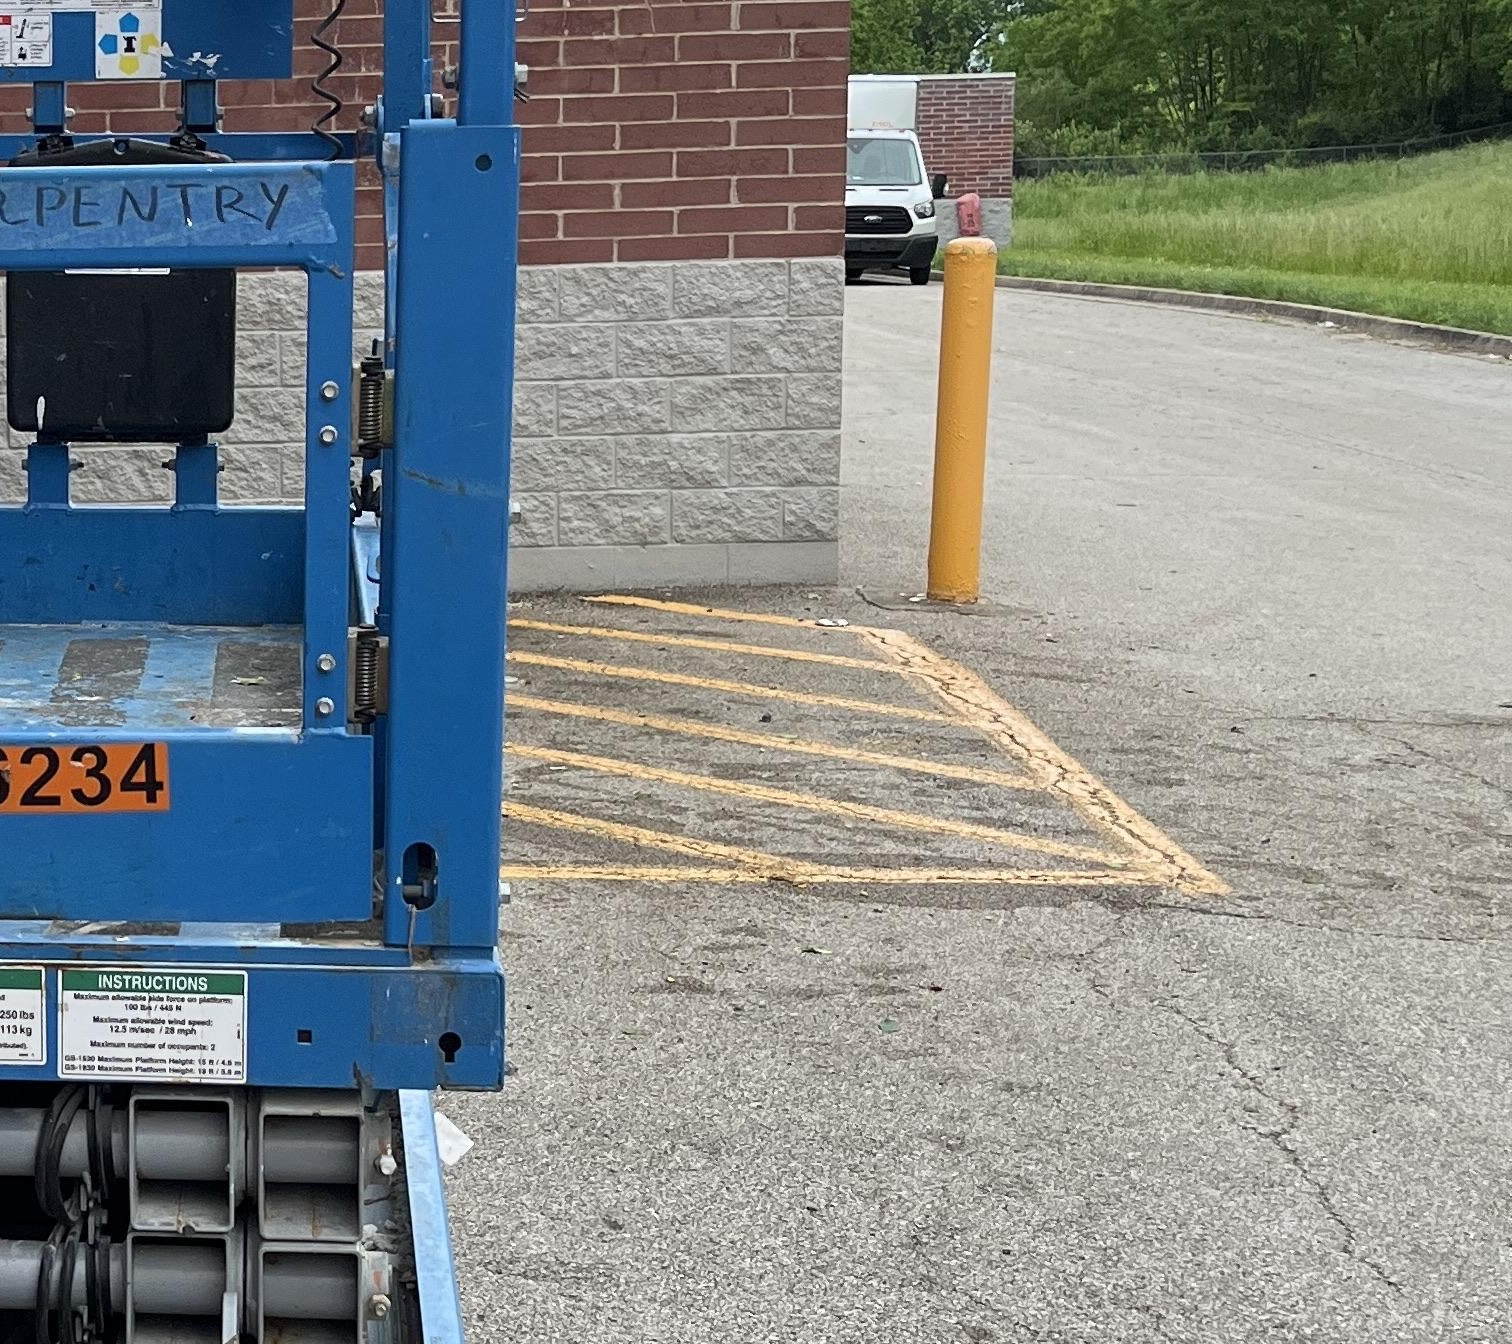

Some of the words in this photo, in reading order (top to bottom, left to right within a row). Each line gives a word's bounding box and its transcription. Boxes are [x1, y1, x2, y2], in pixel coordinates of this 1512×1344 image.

[98, 974, 208, 991] INSTRUCTIONS
[74, 993, 109, 1001] Maximum
[0, 1011, 18, 1019] 250
[20, 1010, 34, 1019] lbs
[93, 1016, 128, 1024] Maximum
[0, 1025, 18, 1034] 113
[20, 1025, 32, 1036] kg
[177, 1028, 196, 1036] mph
[90, 1040, 125, 1048] Maximum
